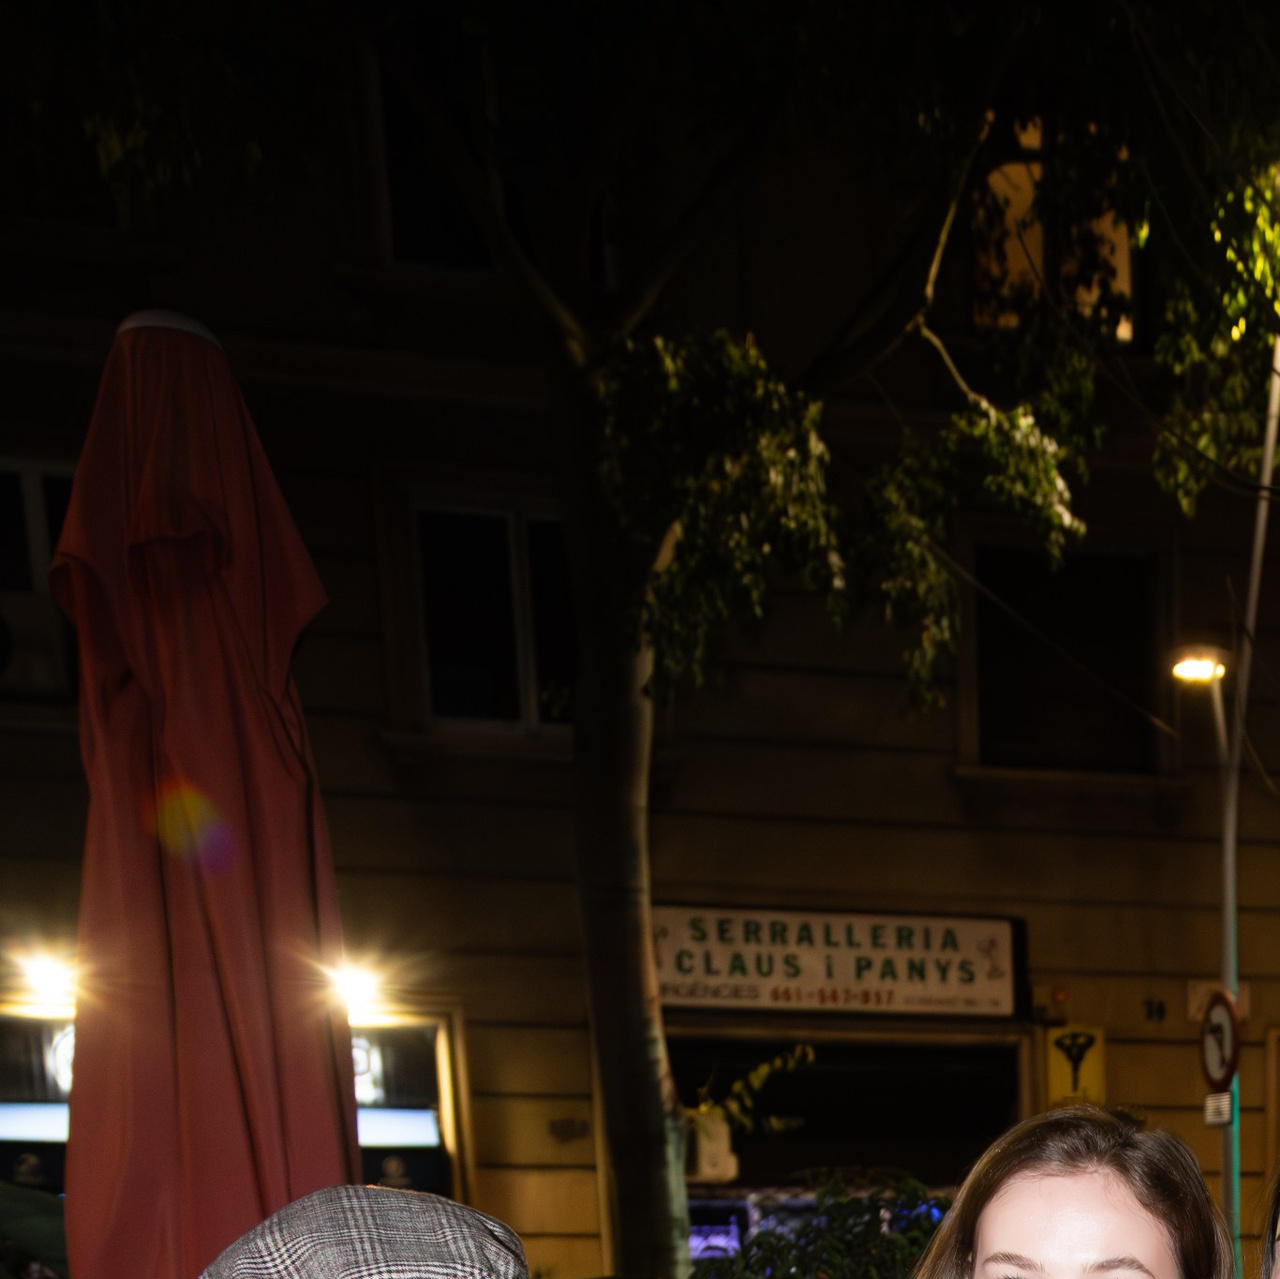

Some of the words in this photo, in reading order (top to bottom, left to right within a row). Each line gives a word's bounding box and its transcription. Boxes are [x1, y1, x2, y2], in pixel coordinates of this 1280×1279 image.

[689, 916, 960, 952] SERRALLERIA
[675, 949, 803, 978] CLAUS
[855, 957, 977, 984] PANYS
